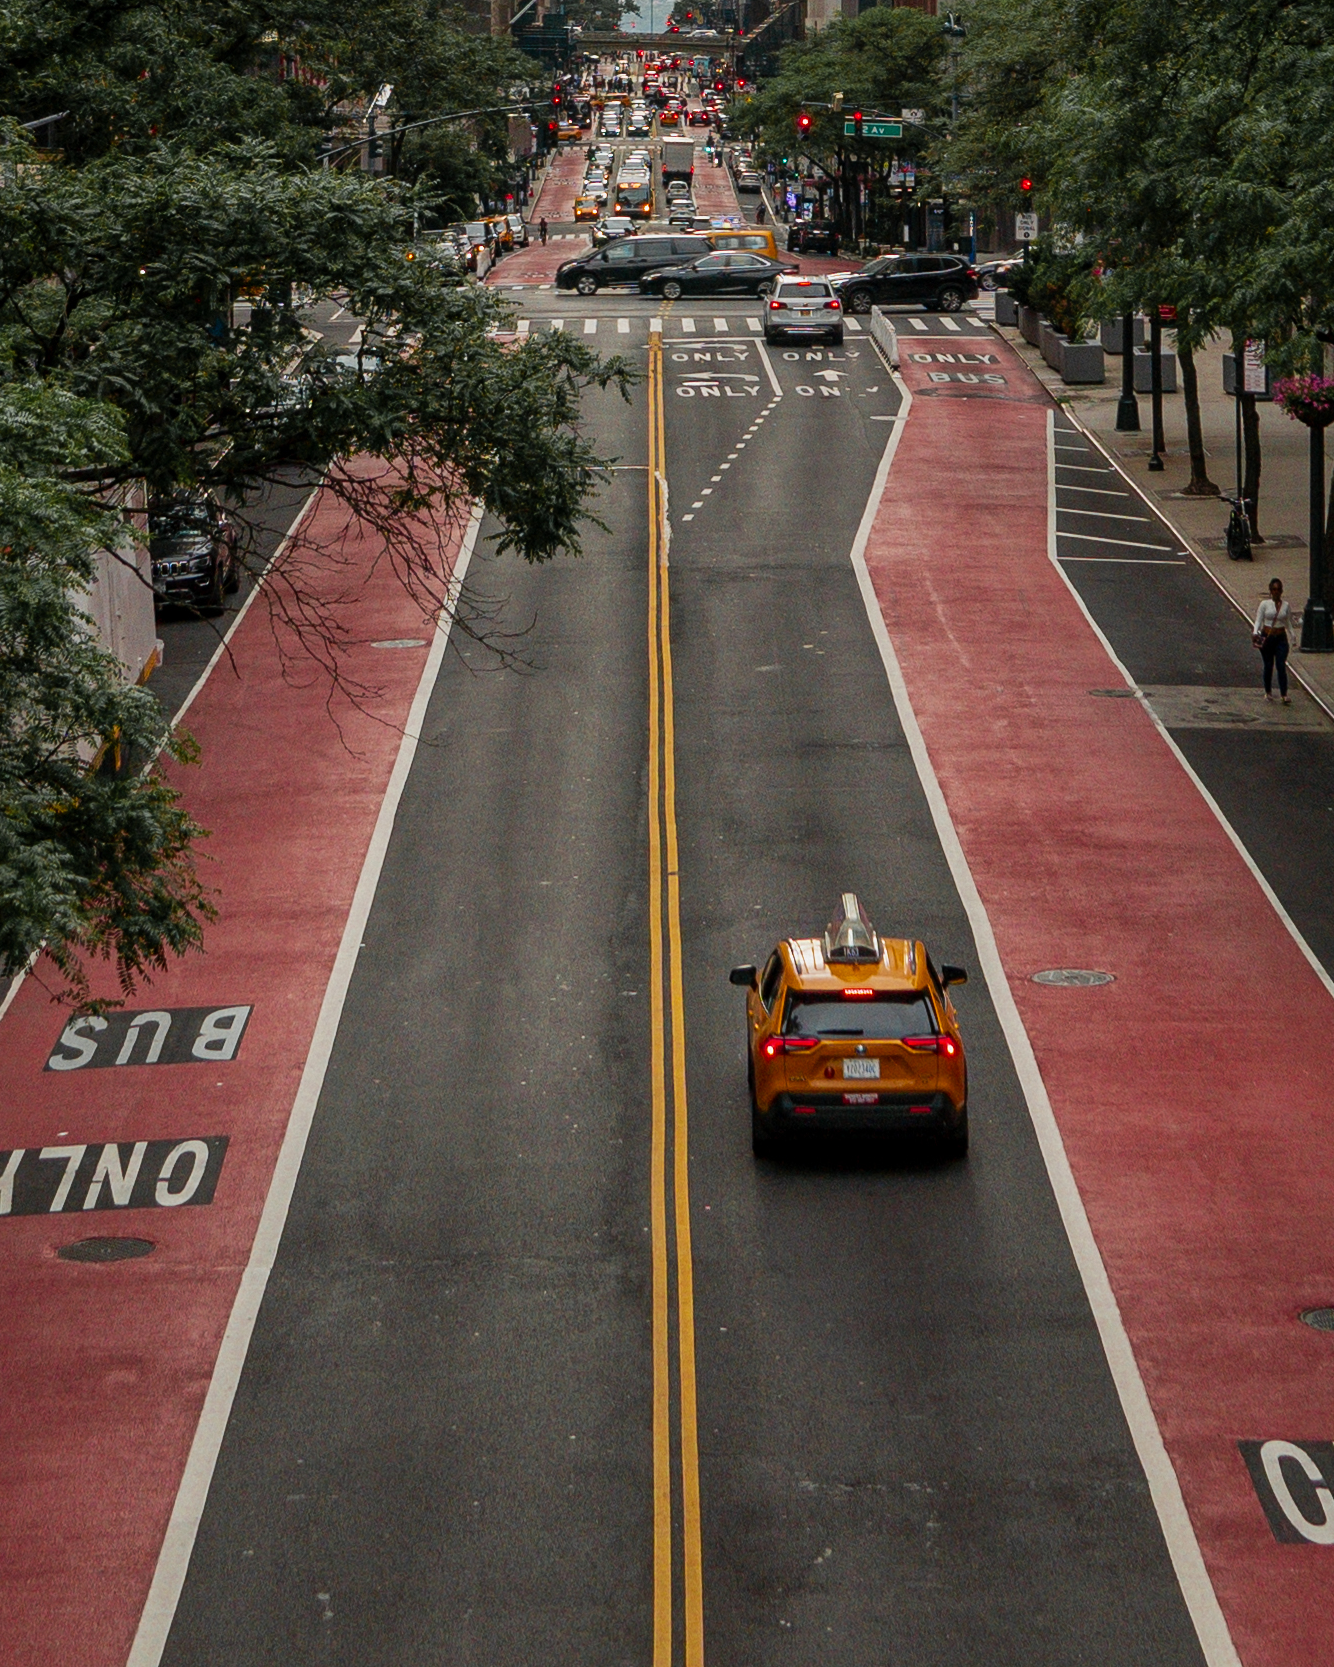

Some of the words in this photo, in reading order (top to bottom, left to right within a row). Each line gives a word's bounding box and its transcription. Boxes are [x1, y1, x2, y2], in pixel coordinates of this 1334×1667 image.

[862, 125, 869, 134] 2
[871, 126, 885, 134] Av
[671, 351, 751, 362] ONLY
[913, 353, 993, 365] ONLY
[929, 372, 1006, 384] BUS
[675, 385, 762, 398] ONLY
[48, 1005, 251, 1071] BUS
